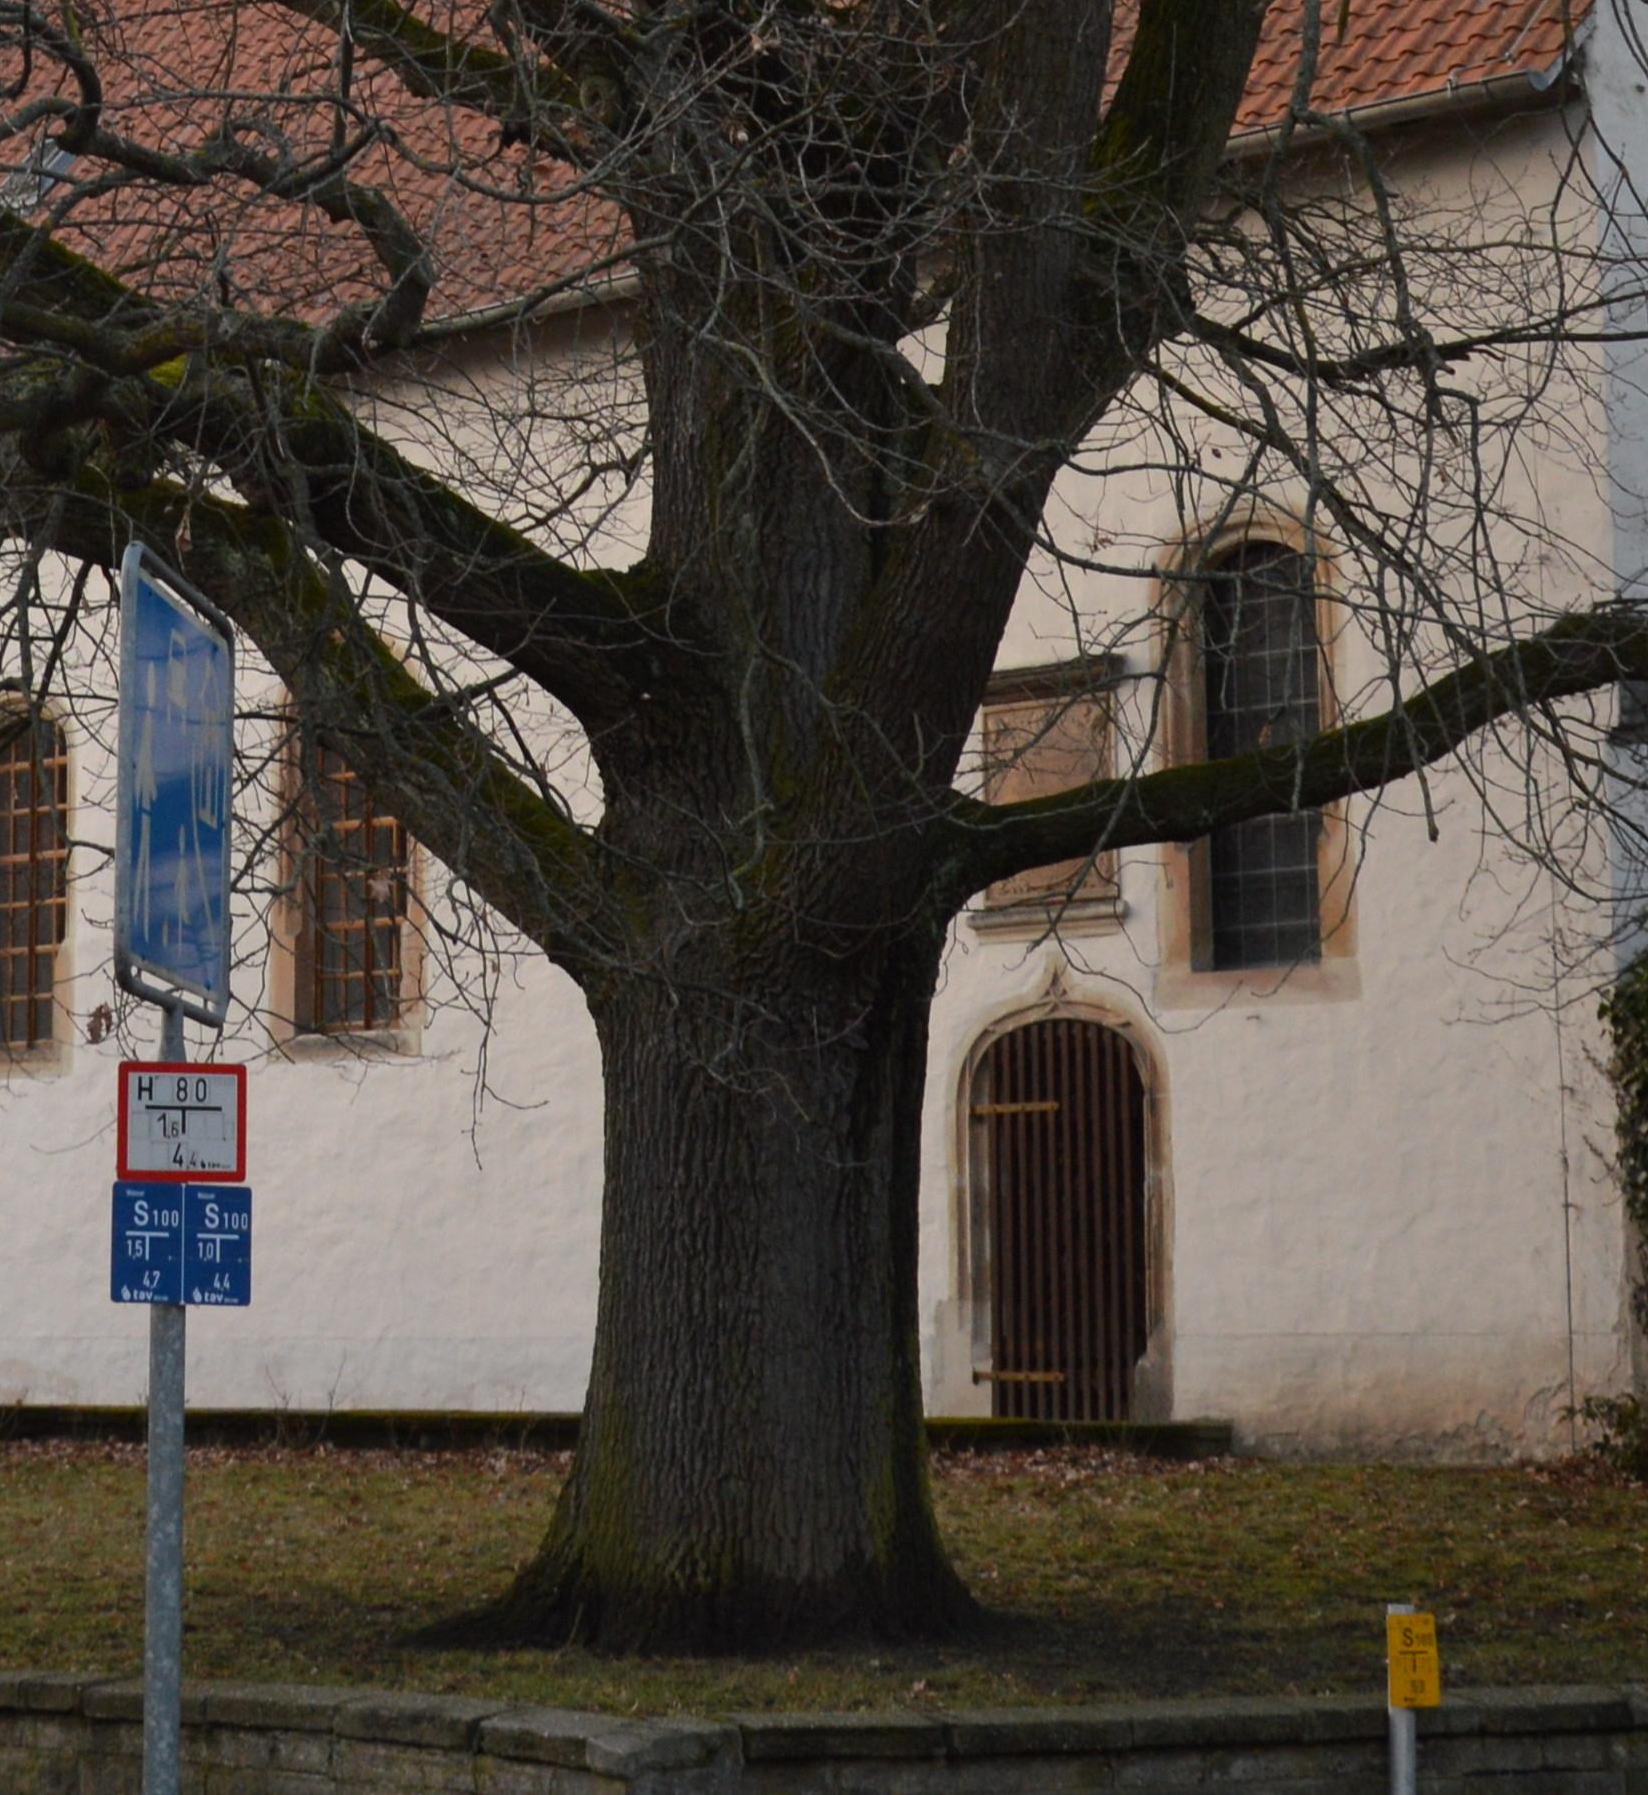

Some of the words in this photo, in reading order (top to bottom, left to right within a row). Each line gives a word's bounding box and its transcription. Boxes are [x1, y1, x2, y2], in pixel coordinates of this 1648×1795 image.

[138, 1075, 153, 1101] H
[176, 1076, 207, 1102] 80
[133, 1200, 149, 1227] S
[153, 1210, 180, 1228] 100
[204, 1202, 220, 1229] S
[223, 1212, 249, 1230] 100
[1403, 1627, 1414, 1647] S
